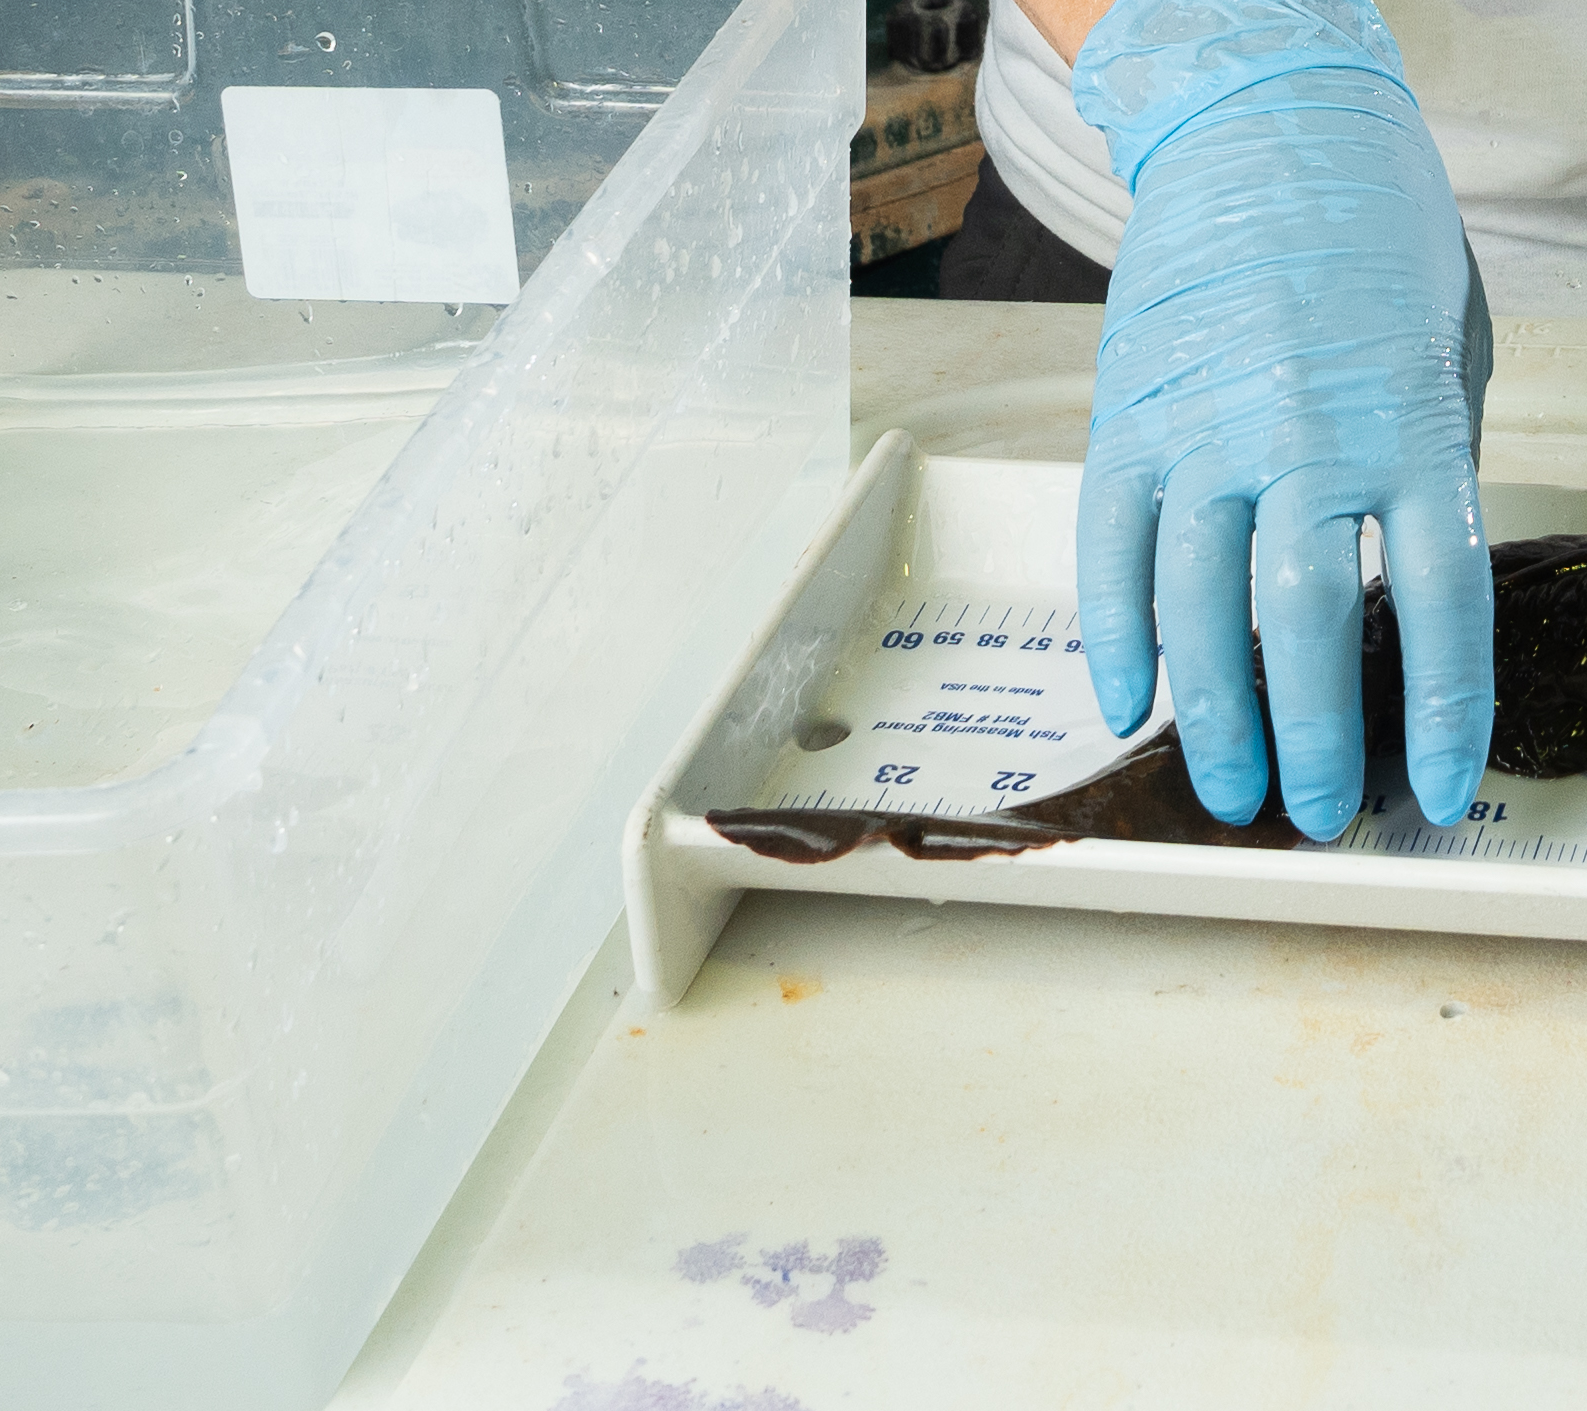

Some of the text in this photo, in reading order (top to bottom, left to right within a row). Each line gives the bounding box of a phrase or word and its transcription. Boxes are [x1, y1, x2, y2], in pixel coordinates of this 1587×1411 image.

[882, 630, 1085, 653] 6 57 58 59 60
[941, 683, 967, 691] USA
[1008, 687, 1044, 696] Made
[922, 711, 974, 722] FMB2
[993, 715, 1031, 725] Part
[872, 722, 1067, 741] Fish Measuring Board
[874, 764, 1037, 791] 22 23
[1358, 794, 1387, 817] 1
[1467, 802, 1508, 823] 18
